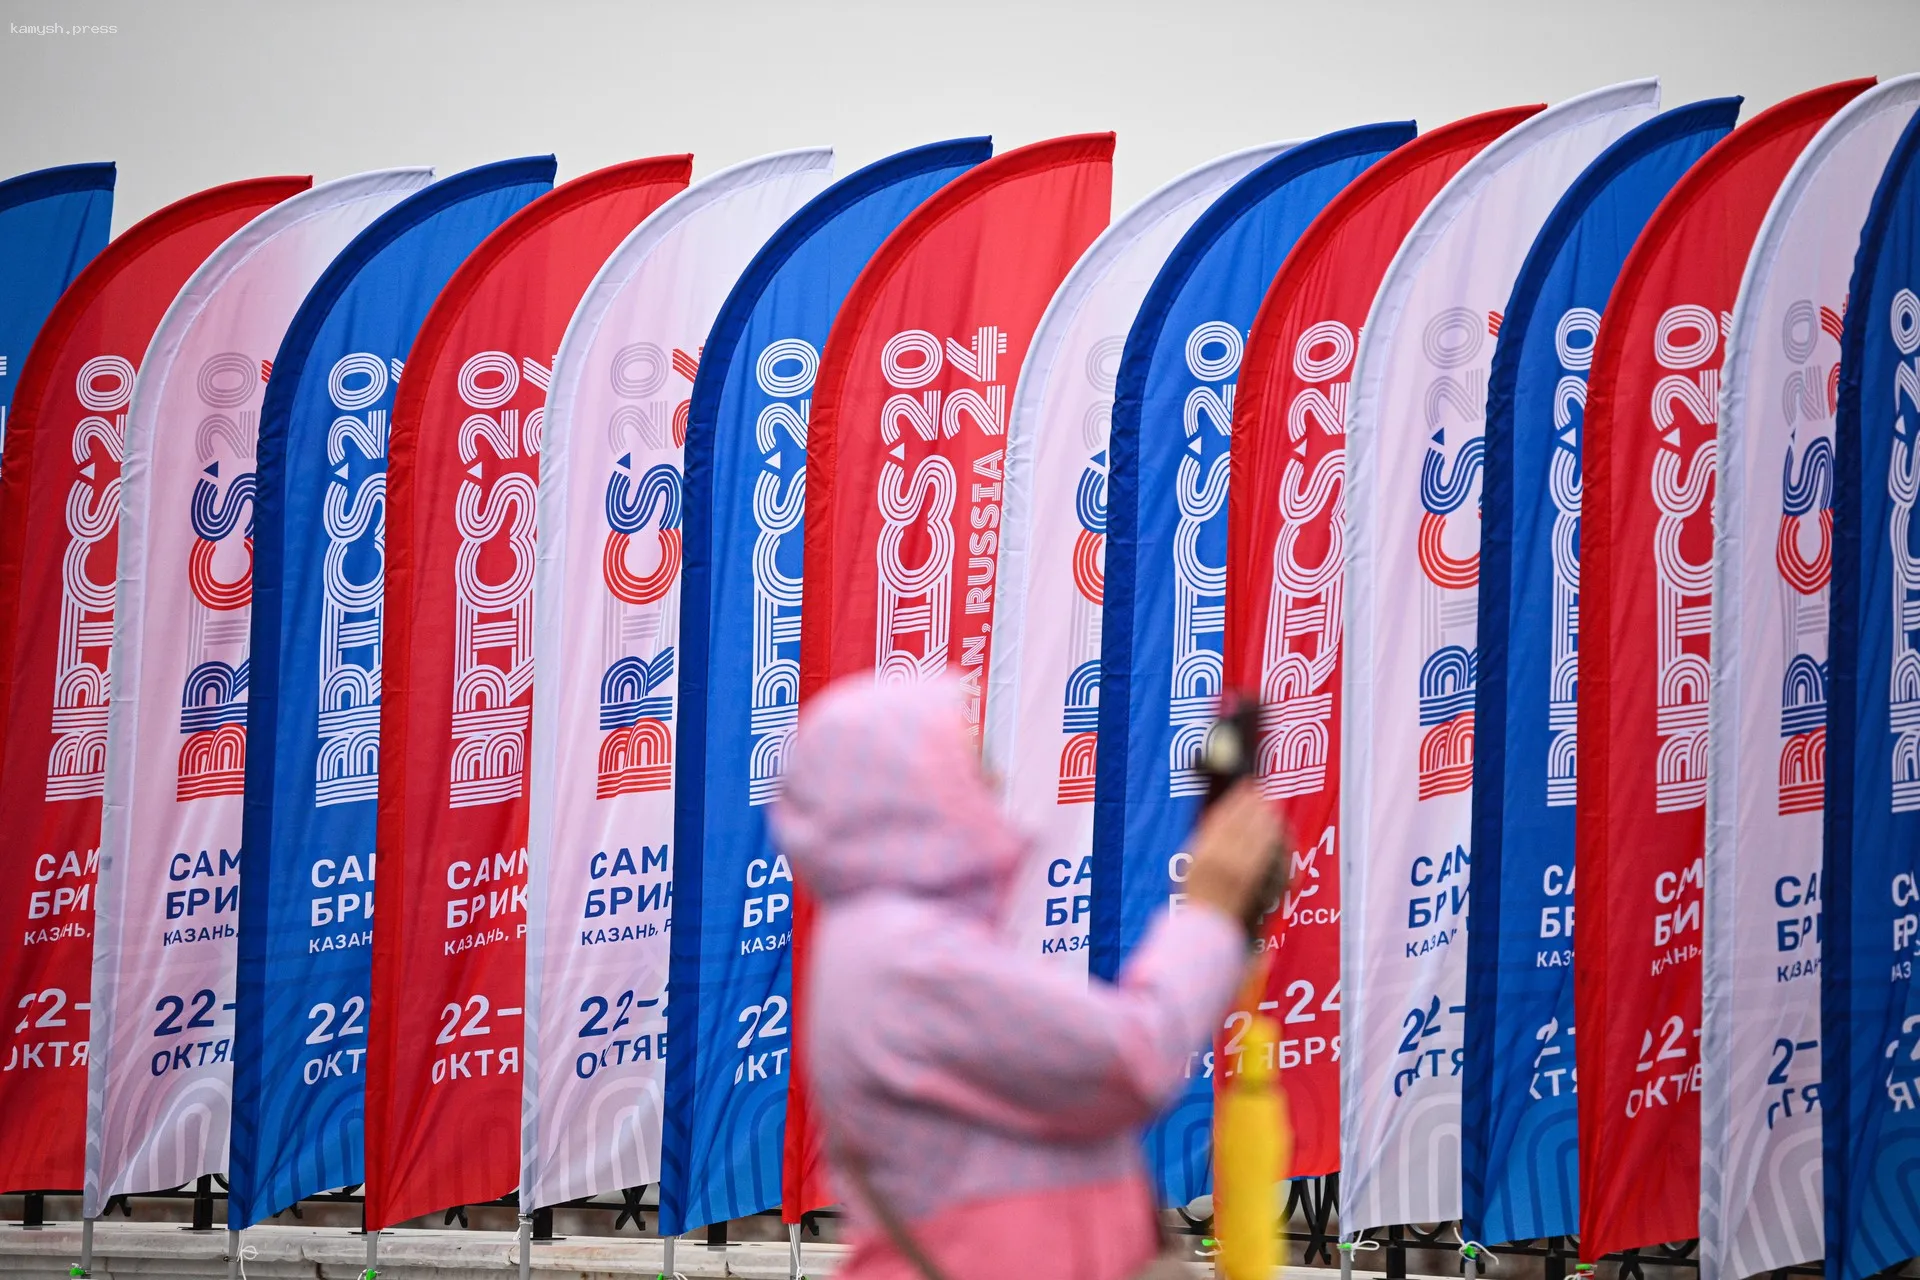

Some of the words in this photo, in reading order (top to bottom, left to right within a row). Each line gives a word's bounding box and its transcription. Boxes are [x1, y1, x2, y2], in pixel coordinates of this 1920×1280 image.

[965, 448, 1004, 615] RUSSIA
[28, 883, 98, 920] БРИ
[24, 922, 91, 946] КАЗНЬ,
[444, 928, 510, 956] КАЗАНЬ,
[581, 923, 659, 946] КАЗАНЬ,
[1537, 951, 1576, 968] КАЗ
[305, 995, 365, 1046] 22
[737, 995, 788, 1050] 22
[151, 1038, 236, 1077] ОКТЯ
[303, 1048, 367, 1086] ОКТ
[431, 1047, 519, 1085] ОКТЯ
